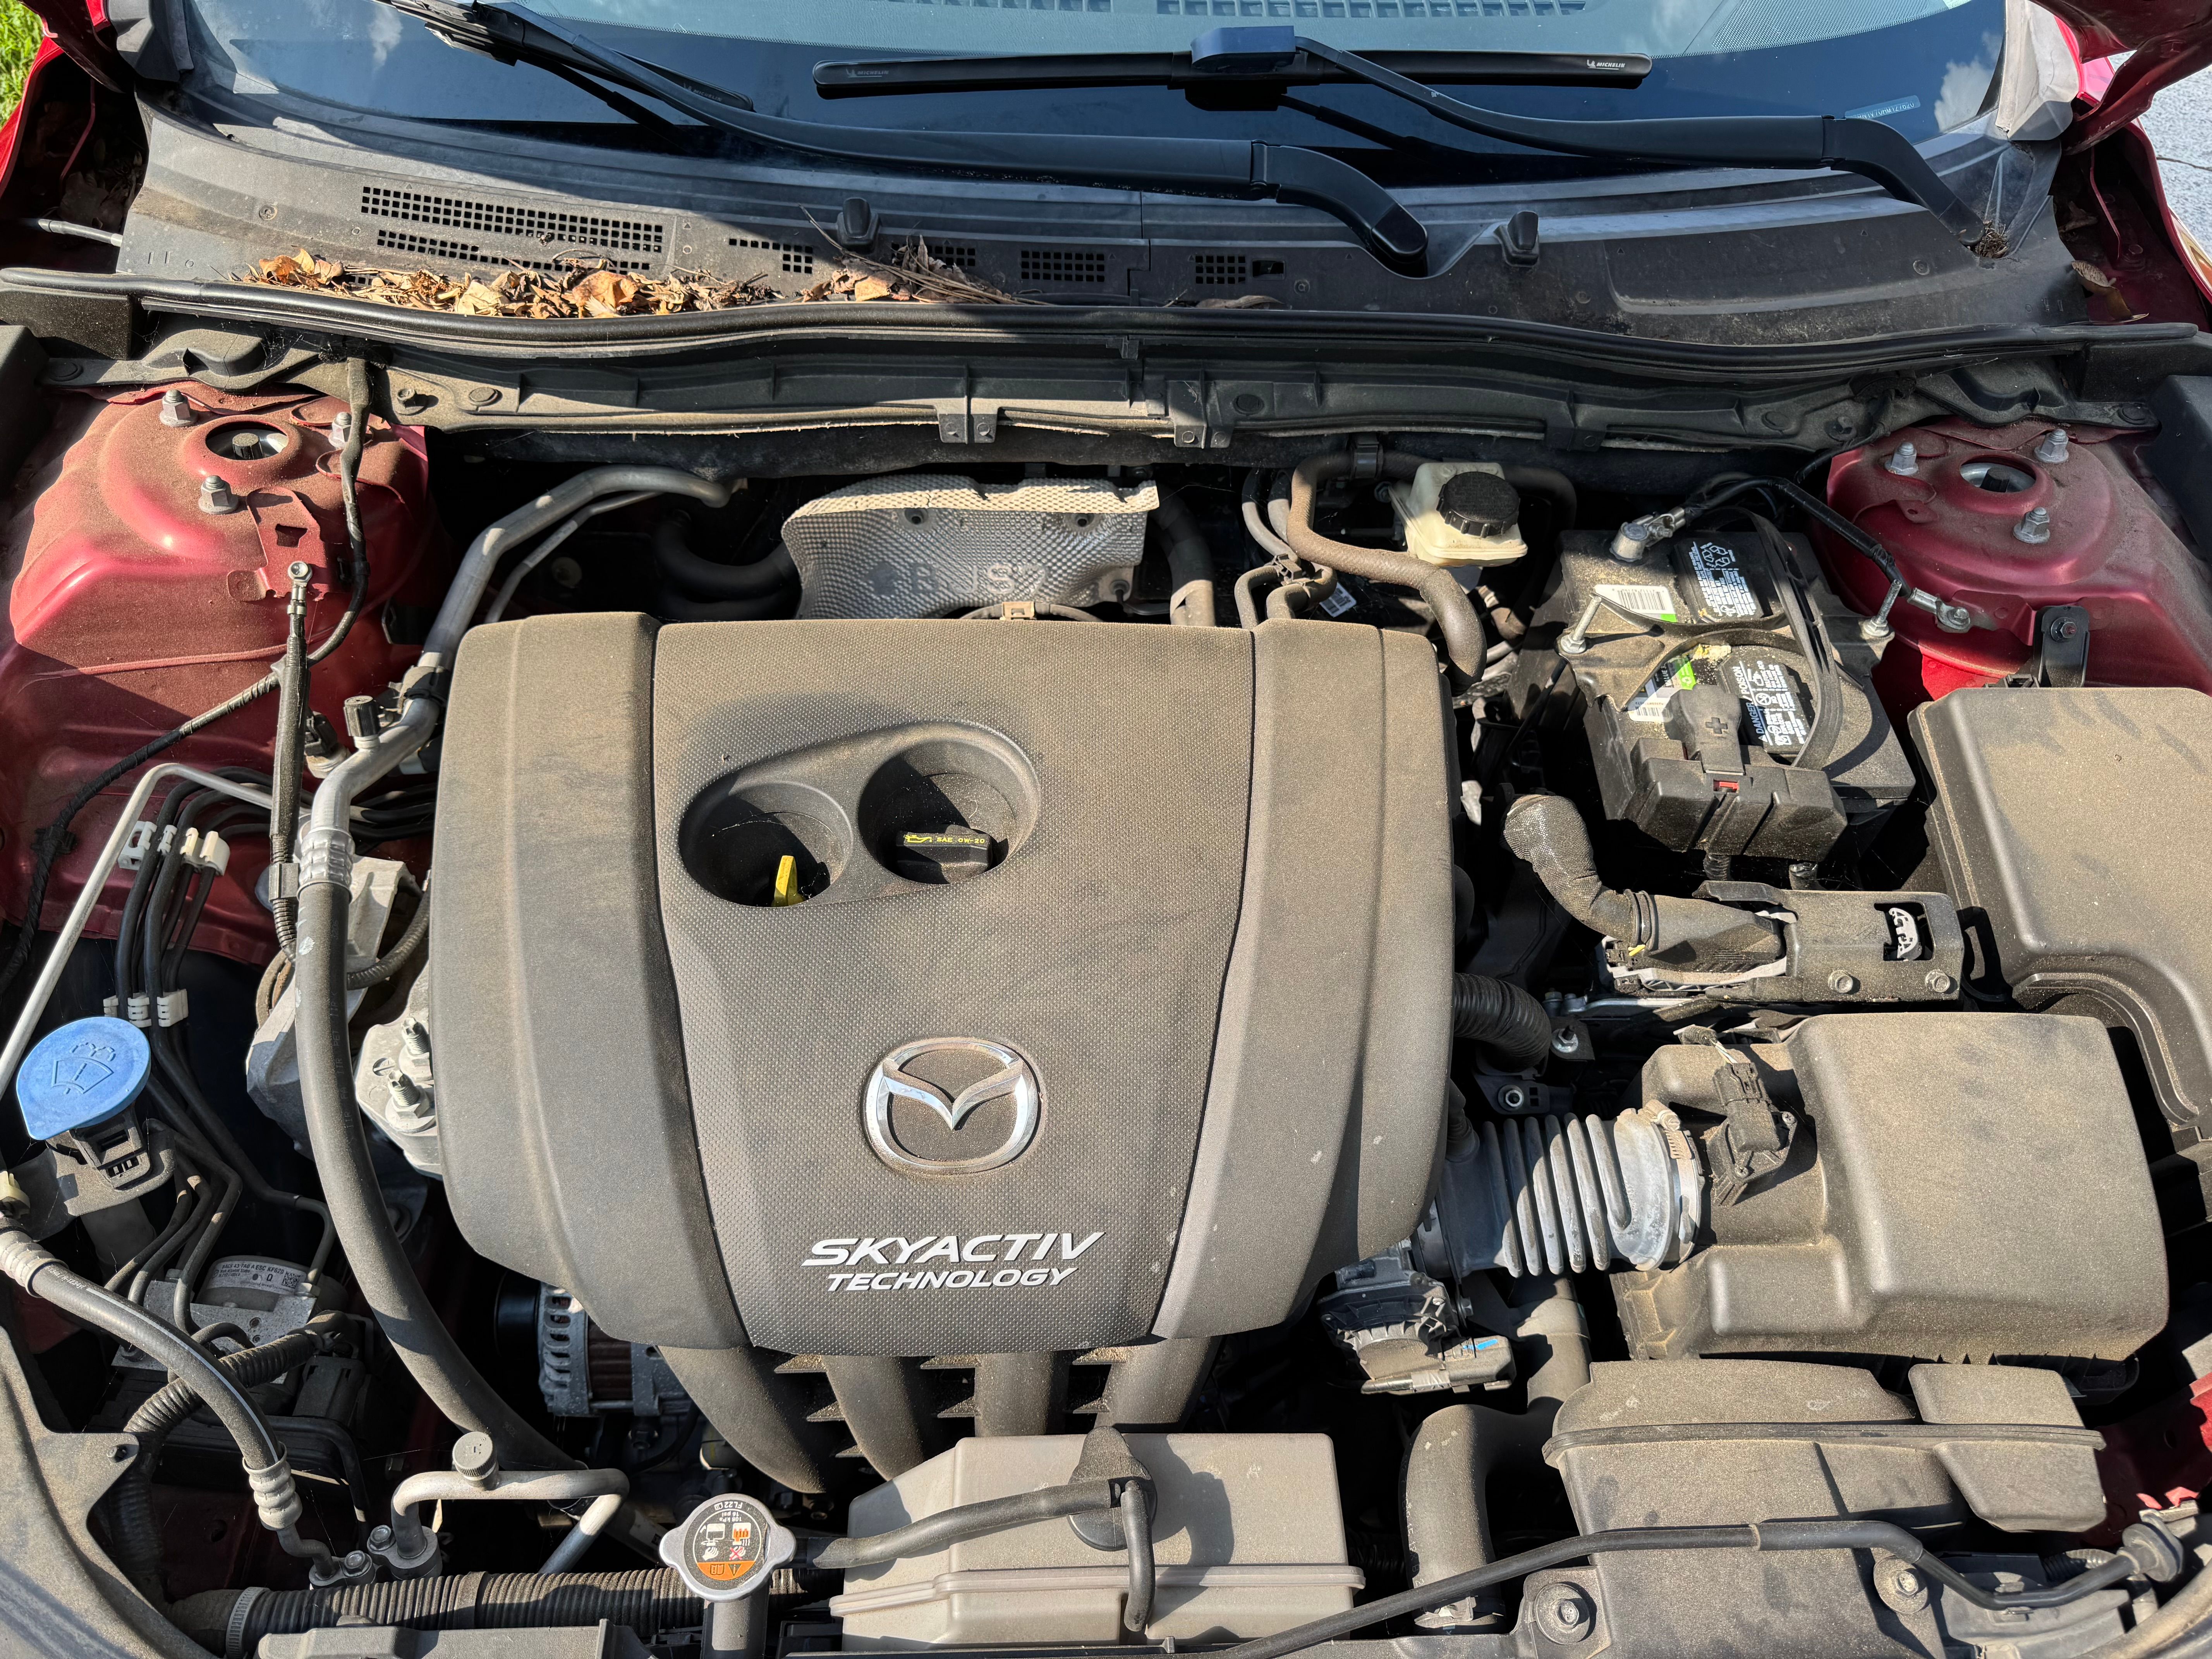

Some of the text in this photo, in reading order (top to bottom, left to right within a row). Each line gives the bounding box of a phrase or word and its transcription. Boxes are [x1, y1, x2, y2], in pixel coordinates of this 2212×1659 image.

[1662, 670, 1673, 686] VALUE
[1731, 666, 1750, 694] POISON
[1745, 702, 1765, 733] DANGER
[800, 1232, 1107, 1267] SKYACTIV
[266, 1274, 273, 1282] Q
[828, 1267, 1079, 1292] TECHNOLOGY
[724, 1501, 743, 1509] FL22
